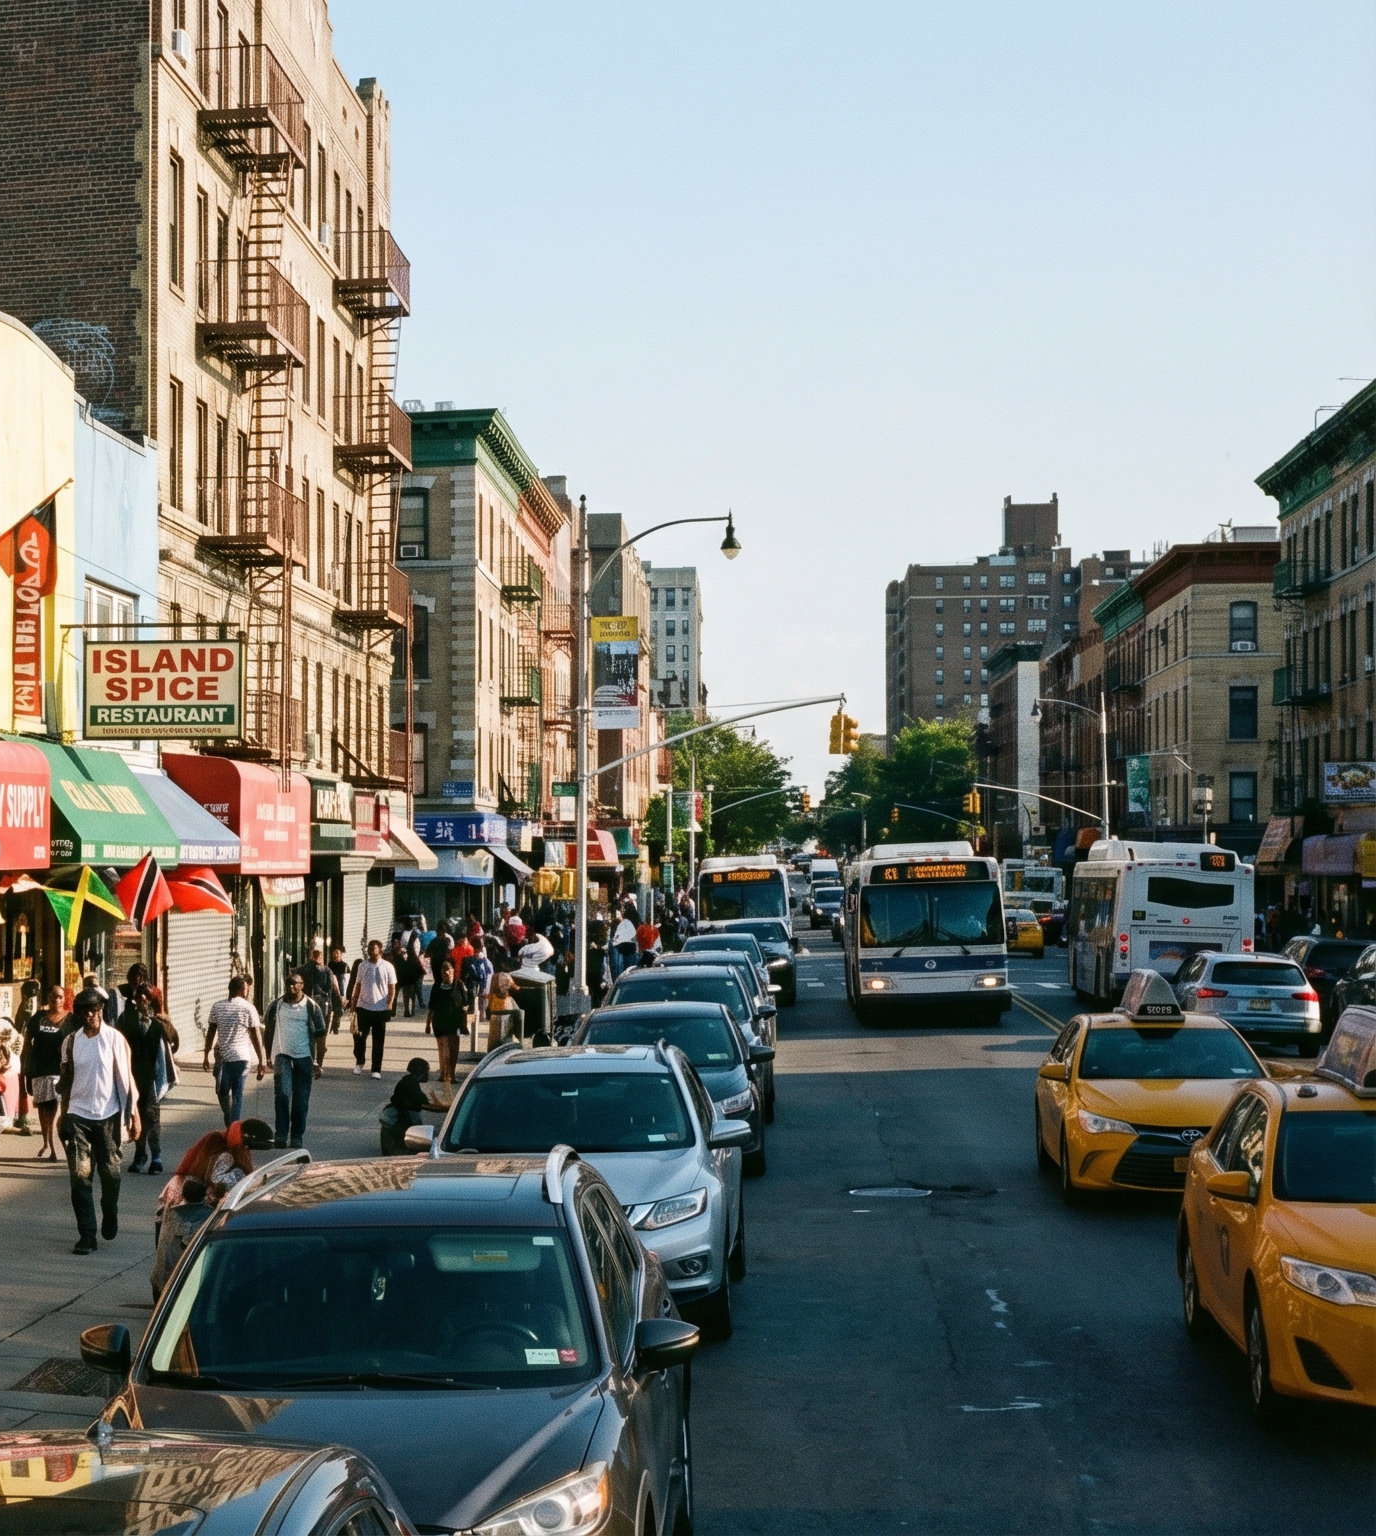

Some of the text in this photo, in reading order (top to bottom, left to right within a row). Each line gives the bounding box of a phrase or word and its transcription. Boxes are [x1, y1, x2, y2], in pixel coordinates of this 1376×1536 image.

[92, 647, 235, 674] ISLAND
[105, 676, 219, 701] SPICE
[96, 707, 227, 723] RESTAURANT
[6, 783, 46, 829] SUPPLY
